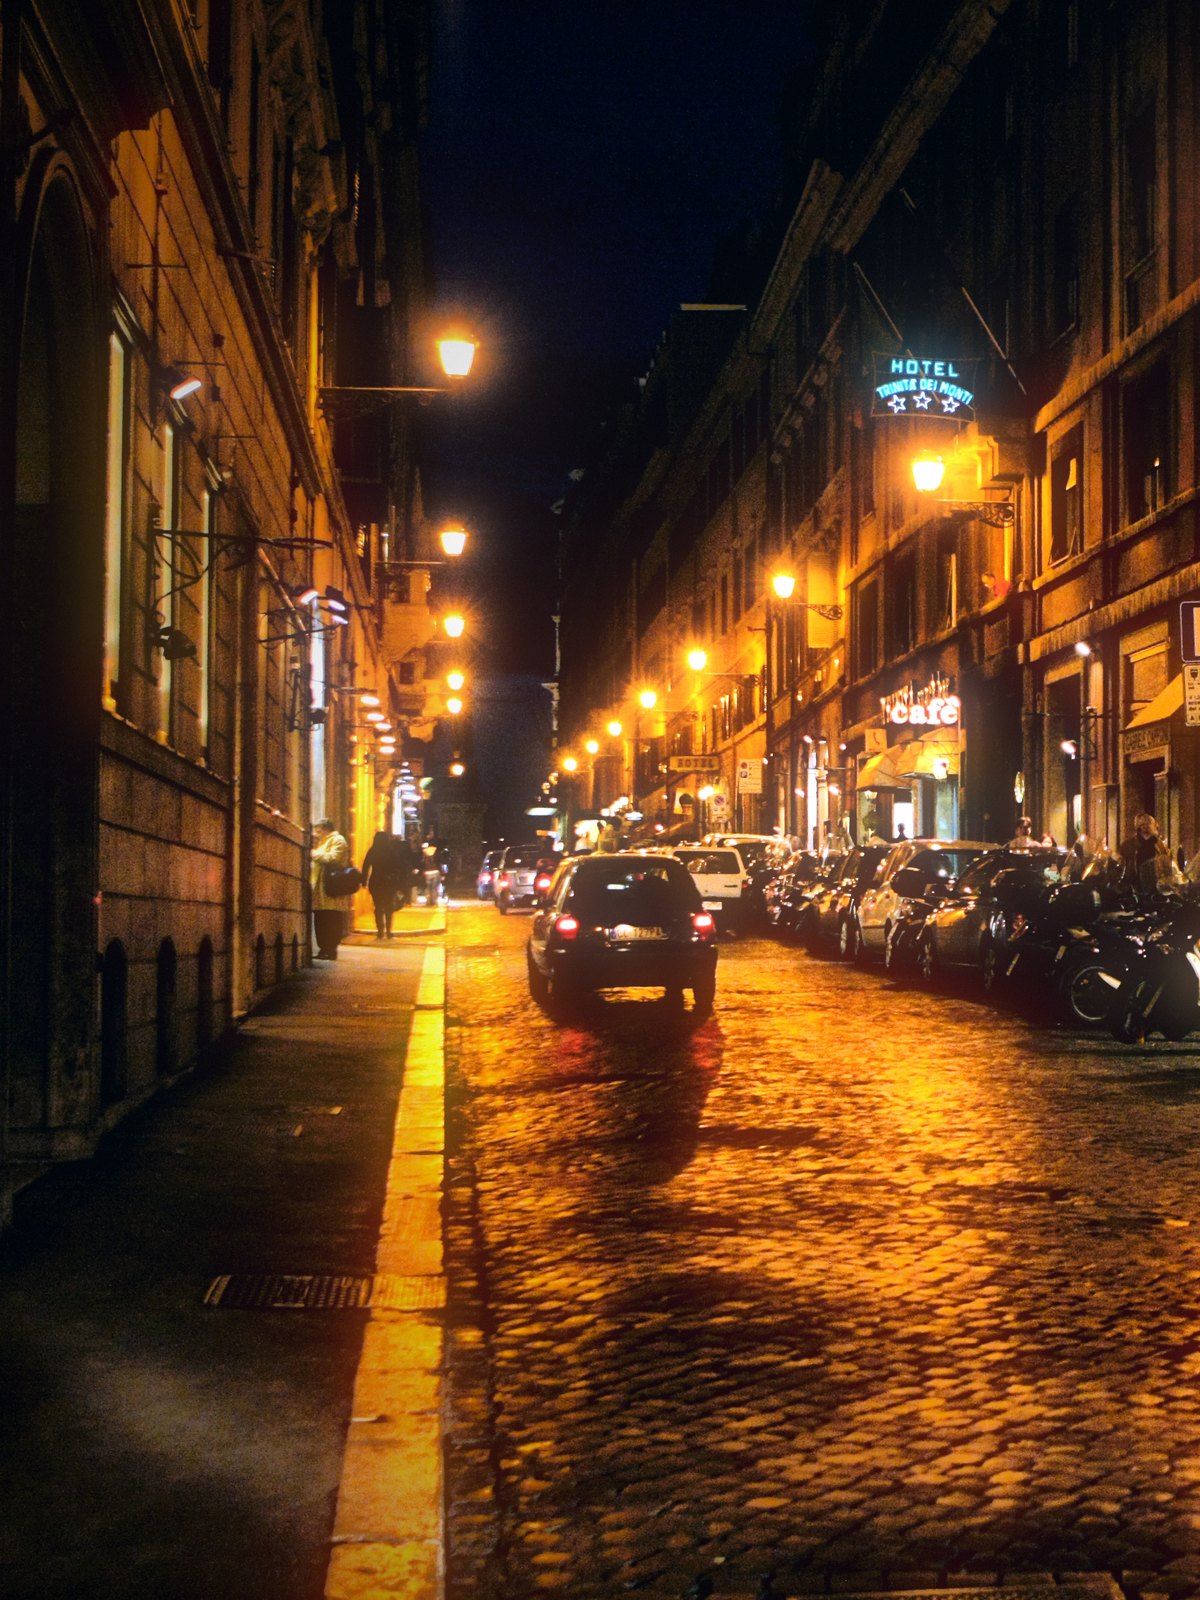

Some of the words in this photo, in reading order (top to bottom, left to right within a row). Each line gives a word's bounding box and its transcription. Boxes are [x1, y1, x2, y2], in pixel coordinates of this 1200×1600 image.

[891, 359, 959, 377] HOTEL
[920, 379, 938, 390] DEI
[940, 381, 974, 404] MONTI
[677, 758, 714, 769] HOTEL
